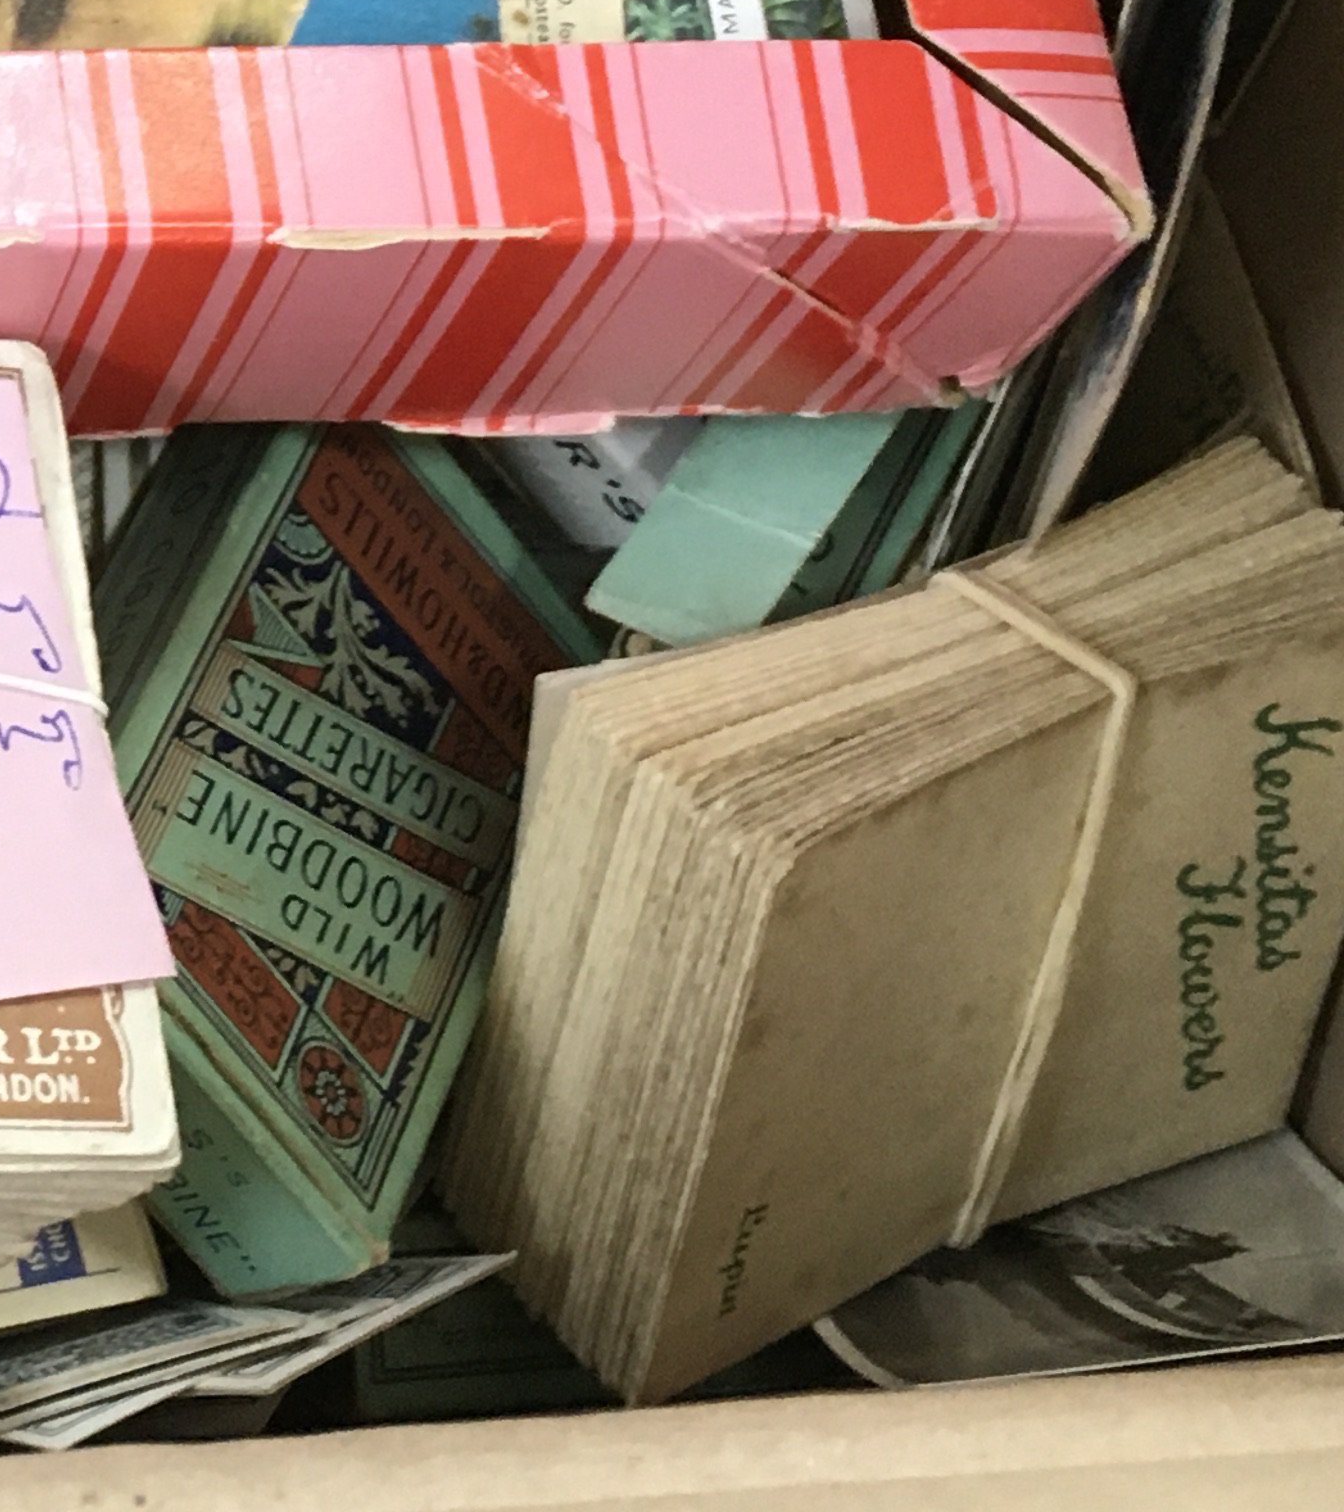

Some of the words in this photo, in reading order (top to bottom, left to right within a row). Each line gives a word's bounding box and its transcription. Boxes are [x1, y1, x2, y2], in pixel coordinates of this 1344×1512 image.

[209, 662, 496, 848] CIGARETTES
[1253, 700, 1339, 974] Kensitas
[1174, 856, 1246, 1092] Flowers
